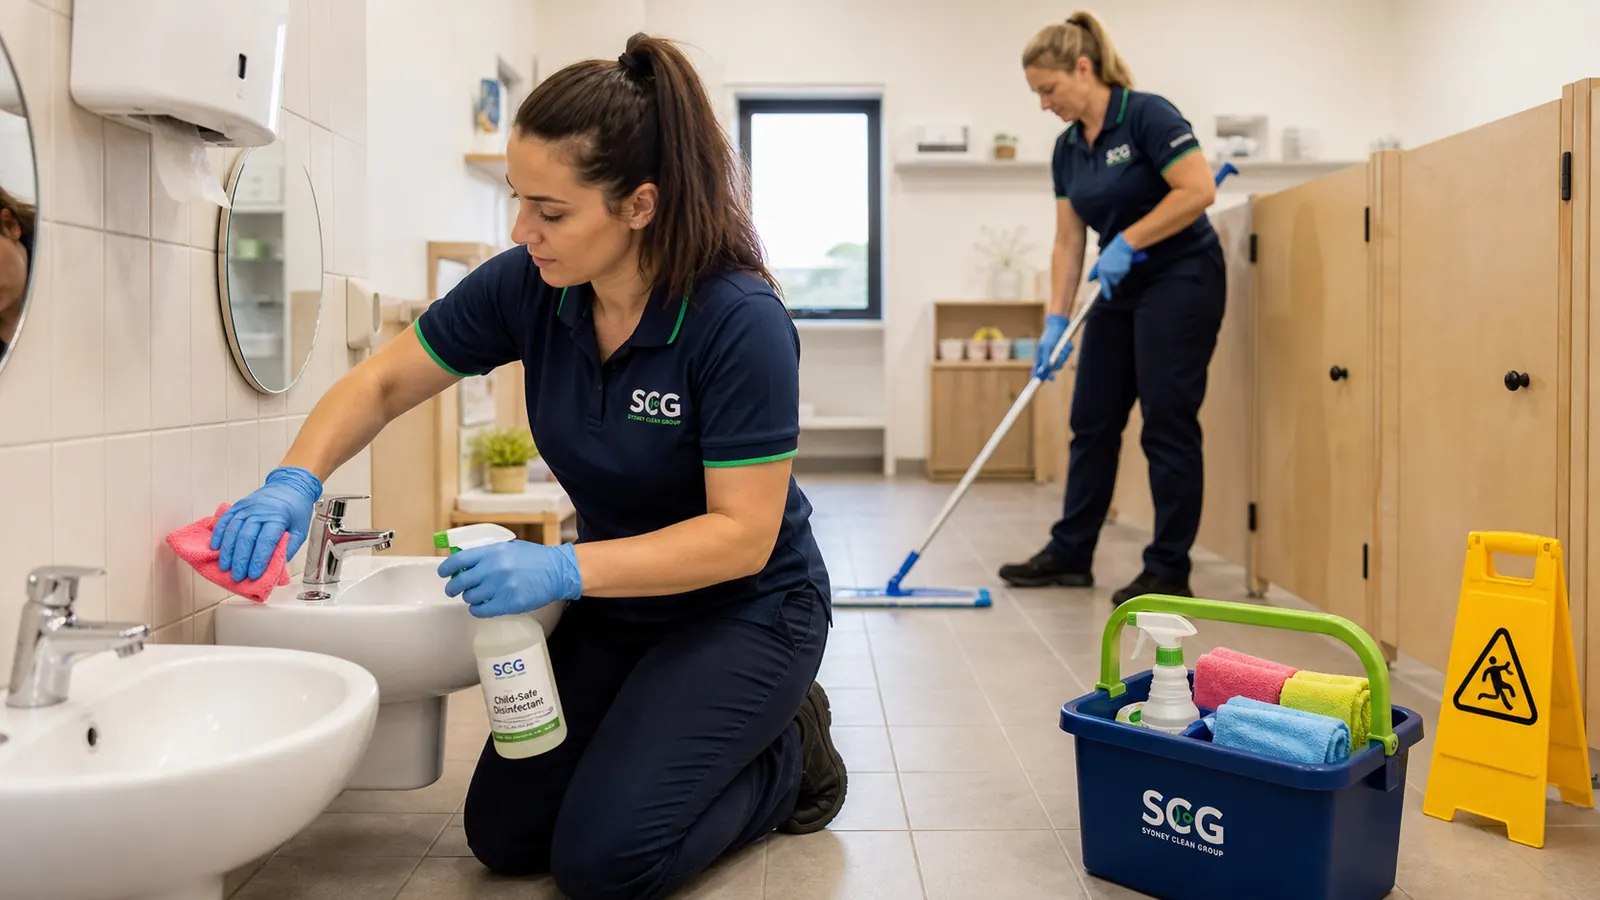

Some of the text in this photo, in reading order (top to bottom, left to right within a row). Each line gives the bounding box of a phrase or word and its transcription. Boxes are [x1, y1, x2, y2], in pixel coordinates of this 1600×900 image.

[630, 389, 681, 417] SCG
[493, 659, 525, 676] SCG
[493, 697, 544, 714] Disinfectant
[494, 689, 538, 705] Child-Safe
[1142, 789, 1224, 844] SCG
[1142, 827, 1224, 857] SYDNEY CLEAN GROUP
